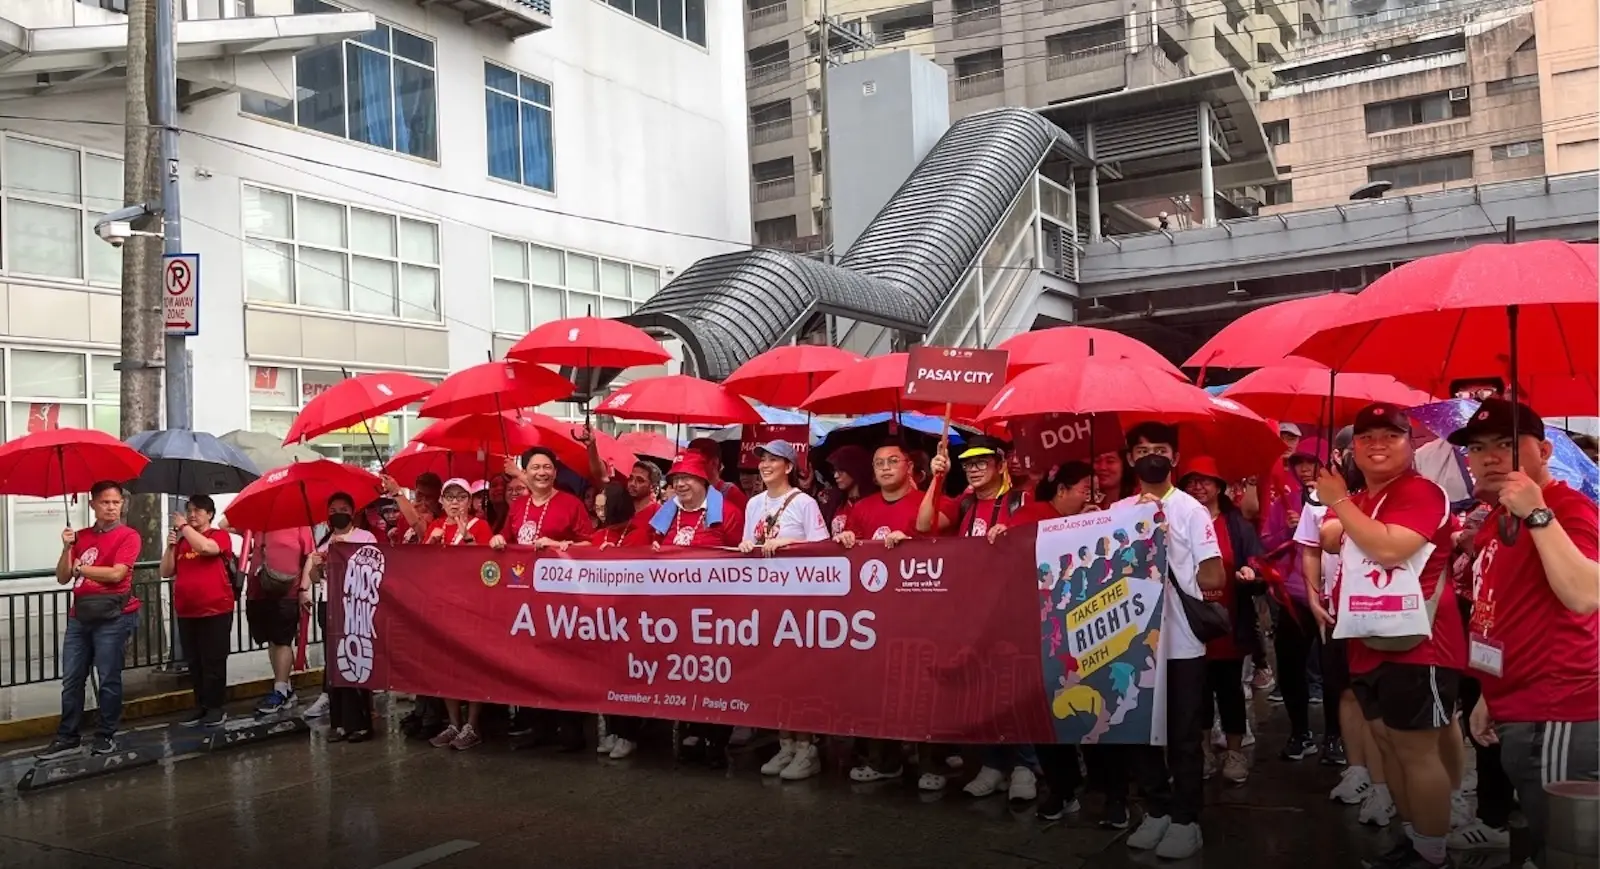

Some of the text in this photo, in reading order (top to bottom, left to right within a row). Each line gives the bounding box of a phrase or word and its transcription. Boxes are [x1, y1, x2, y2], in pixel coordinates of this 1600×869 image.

[168, 309, 185, 319] ZONE
[175, 297, 194, 307] AWAY
[918, 368, 993, 384] PASAY CITY
[1041, 419, 1091, 449] DOH
[1042, 516, 1112, 533] WORLD AIDS DAY 2024
[541, 566, 841, 586] 2024 Philippine World AIDS Day Walk
[900, 557, 943, 580] U=U
[344, 560, 382, 605] AIDS
[1072, 584, 1124, 624] TAKE THE
[343, 597, 377, 639] WALK
[510, 602, 877, 650] A Walk to End AIDS
[1075, 593, 1146, 652] RIGHTS
[628, 652, 732, 684] by 2030
[1081, 646, 1109, 672] PATH
[608, 691, 750, 712] December 1, 2024 Pasig City
